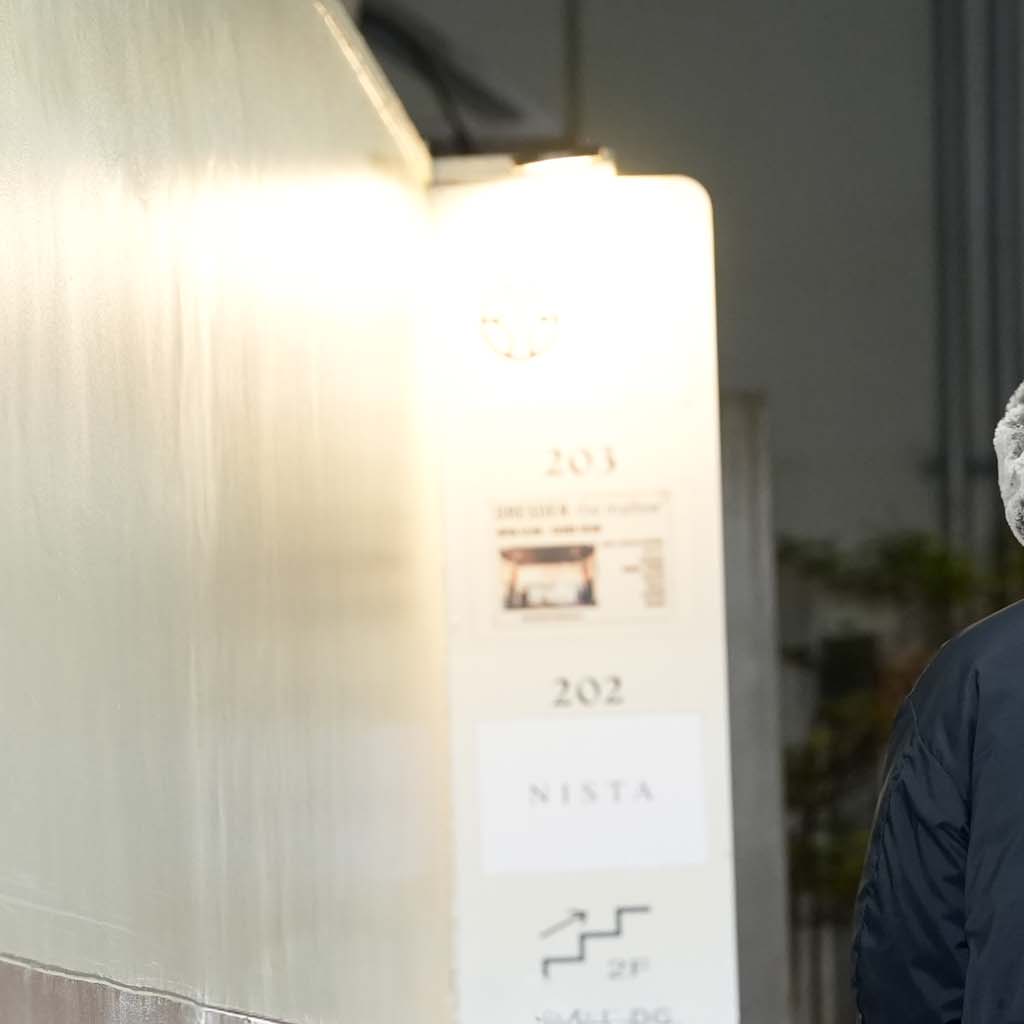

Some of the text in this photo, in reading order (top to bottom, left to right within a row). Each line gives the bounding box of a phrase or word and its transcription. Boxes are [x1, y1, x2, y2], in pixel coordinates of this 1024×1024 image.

[545, 446, 617, 477] 203
[553, 675, 625, 707] 202
[529, 780, 654, 806] NISTA
[609, 957, 650, 980] 2F
